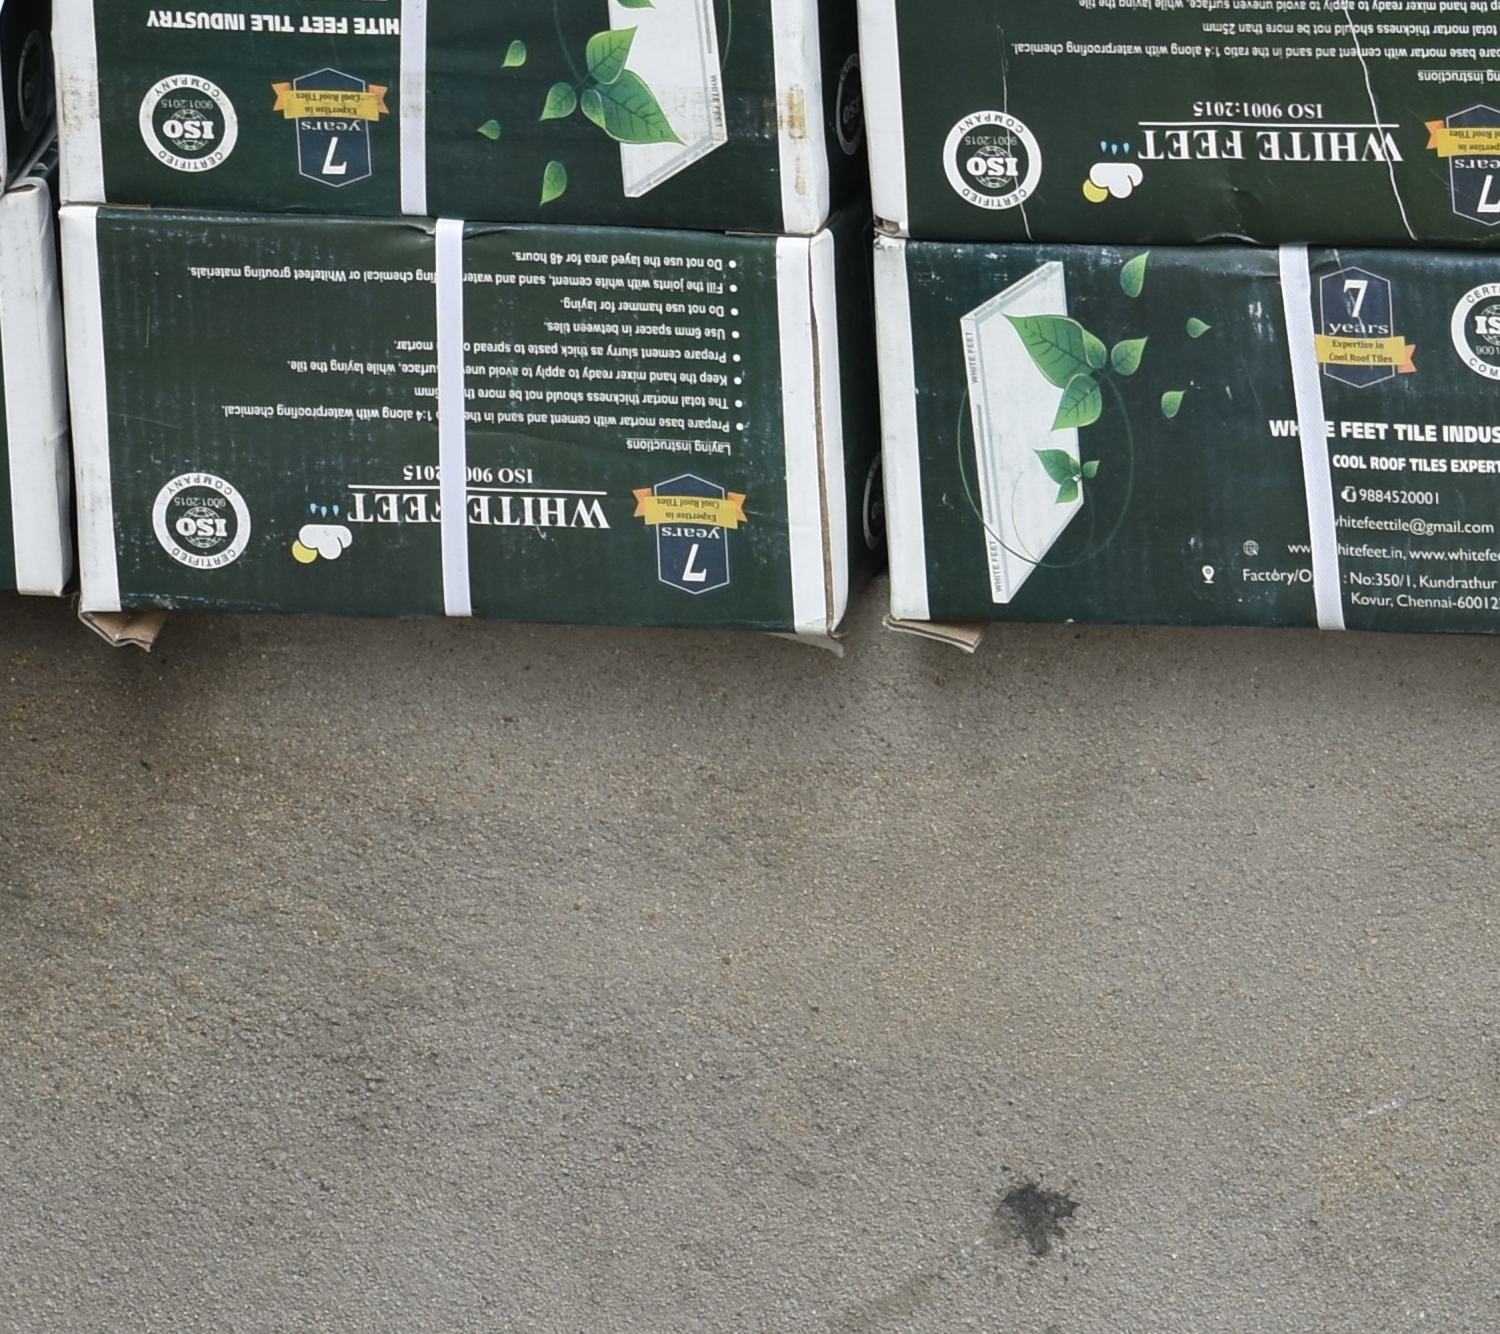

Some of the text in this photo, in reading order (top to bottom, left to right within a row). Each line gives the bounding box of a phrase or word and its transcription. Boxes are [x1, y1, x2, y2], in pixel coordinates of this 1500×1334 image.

[146, 9, 349, 35] FEET TILE INDUSTRY
[1202, 22, 1237, 36] 25mm
[1237, 22, 1264, 36] than
[1265, 23, 1295, 34] more
[1296, 23, 1311, 36] be
[1312, 23, 1333, 36] not
[1333, 22, 1375, 36] should
[1375, 23, 1431, 37] thickness
[1432, 24, 1471, 37] mortar
[1471, 24, 1498, 37] total
[1417, 70, 1484, 83] instructions
[1192, 100, 1324, 120] ISO 9001:2015
[1137, 126, 1404, 165] WHITE FEET
[511, 251, 724, 272] Do not use the layed area for 48 hours.
[1339, 420, 1390, 441] FEET
[1392, 422, 1438, 443] TILE
[625, 438, 732, 456] Laying instructions
[1331, 453, 1368, 470] COOL
[1369, 455, 1407, 472] ROOF
[1408, 457, 1448, 473] TILES
[1357, 487, 1440, 505] 9884520001
[660, 524, 721, 543] years
[681, 542, 708, 583] 7
